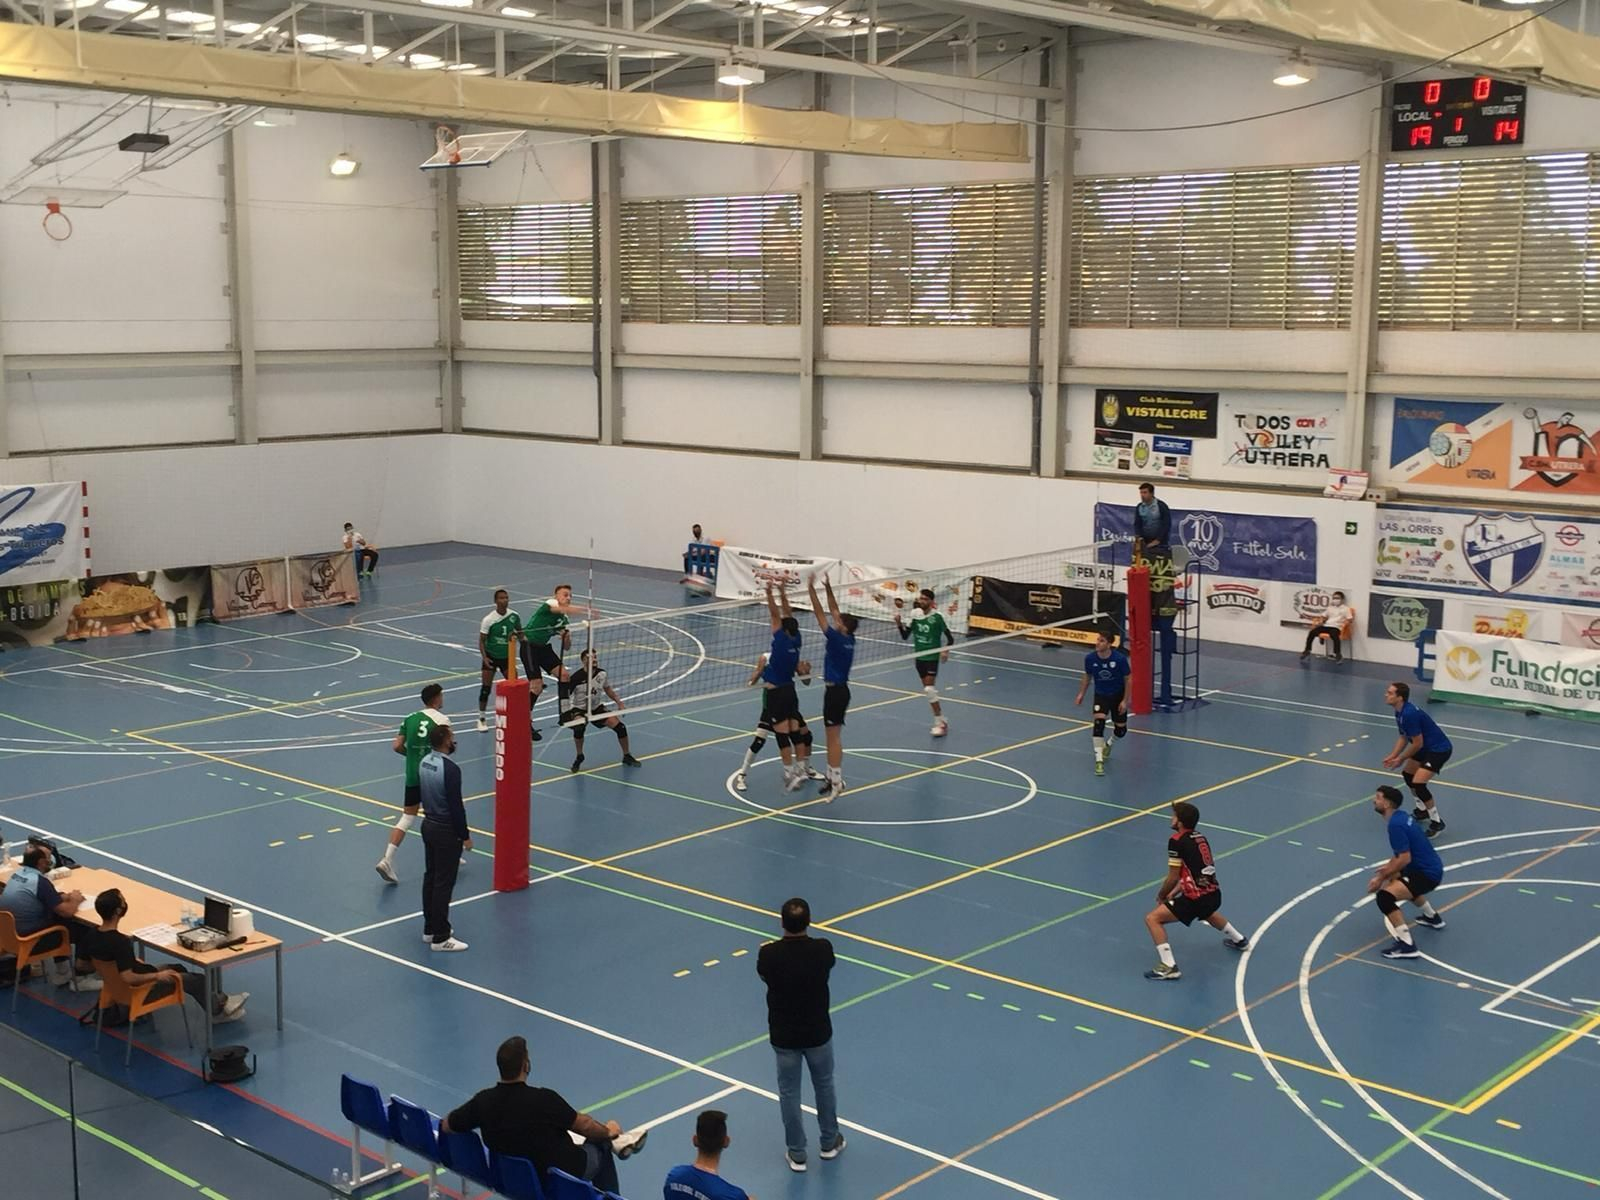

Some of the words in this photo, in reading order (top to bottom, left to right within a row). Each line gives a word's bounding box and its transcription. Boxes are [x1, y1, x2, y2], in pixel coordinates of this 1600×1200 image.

[1424, 81, 1441, 104] 0
[1474, 77, 1491, 100] 0
[1398, 112, 1432, 122] LOCAL
[1481, 104, 1517, 116] VISITANTE
[1410, 126, 1432, 146] 19
[1495, 120, 1519, 142] 14
[1125, 406, 1208, 420] VISTALEGRE
[1245, 450, 1331, 469] UTRERA
[1191, 519, 1215, 542] 10
[1379, 522, 1399, 532] LAS
[1211, 594, 1261, 610] OBANDO
[1490, 676, 1519, 690] CAJA
[1524, 680, 1560, 697] RURAL
[1563, 688, 1582, 699] DE
[417, 720, 429, 738] 3
[496, 713, 508, 781] MONDO
